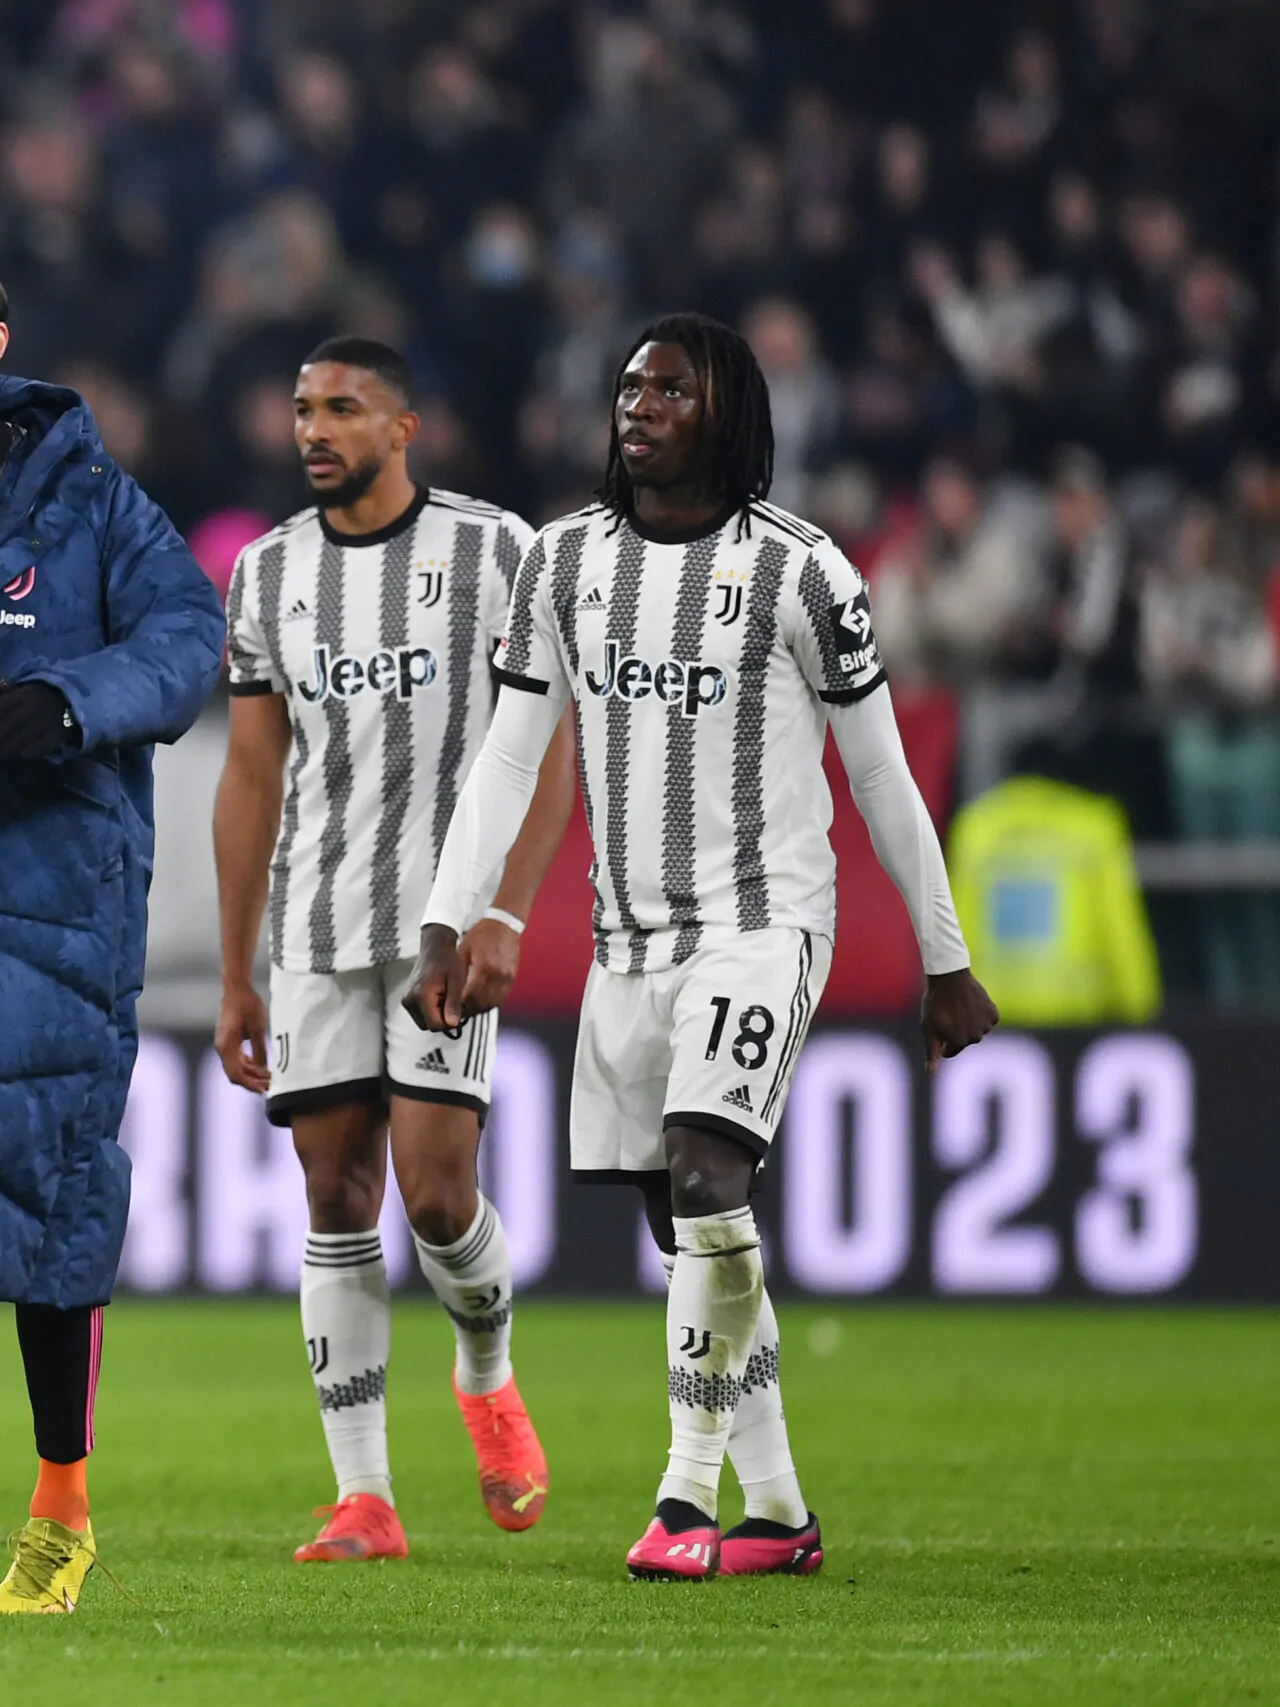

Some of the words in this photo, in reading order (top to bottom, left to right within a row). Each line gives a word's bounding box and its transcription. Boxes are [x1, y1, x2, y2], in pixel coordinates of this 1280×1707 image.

[296, 644, 438, 702] Jeep
[584, 640, 728, 719] Jeep
[838, 637, 876, 673] Bitge
[705, 996, 775, 1071] 18
[722, 1095, 753, 1114] adidas
[637, 1033, 1197, 1288] 023
